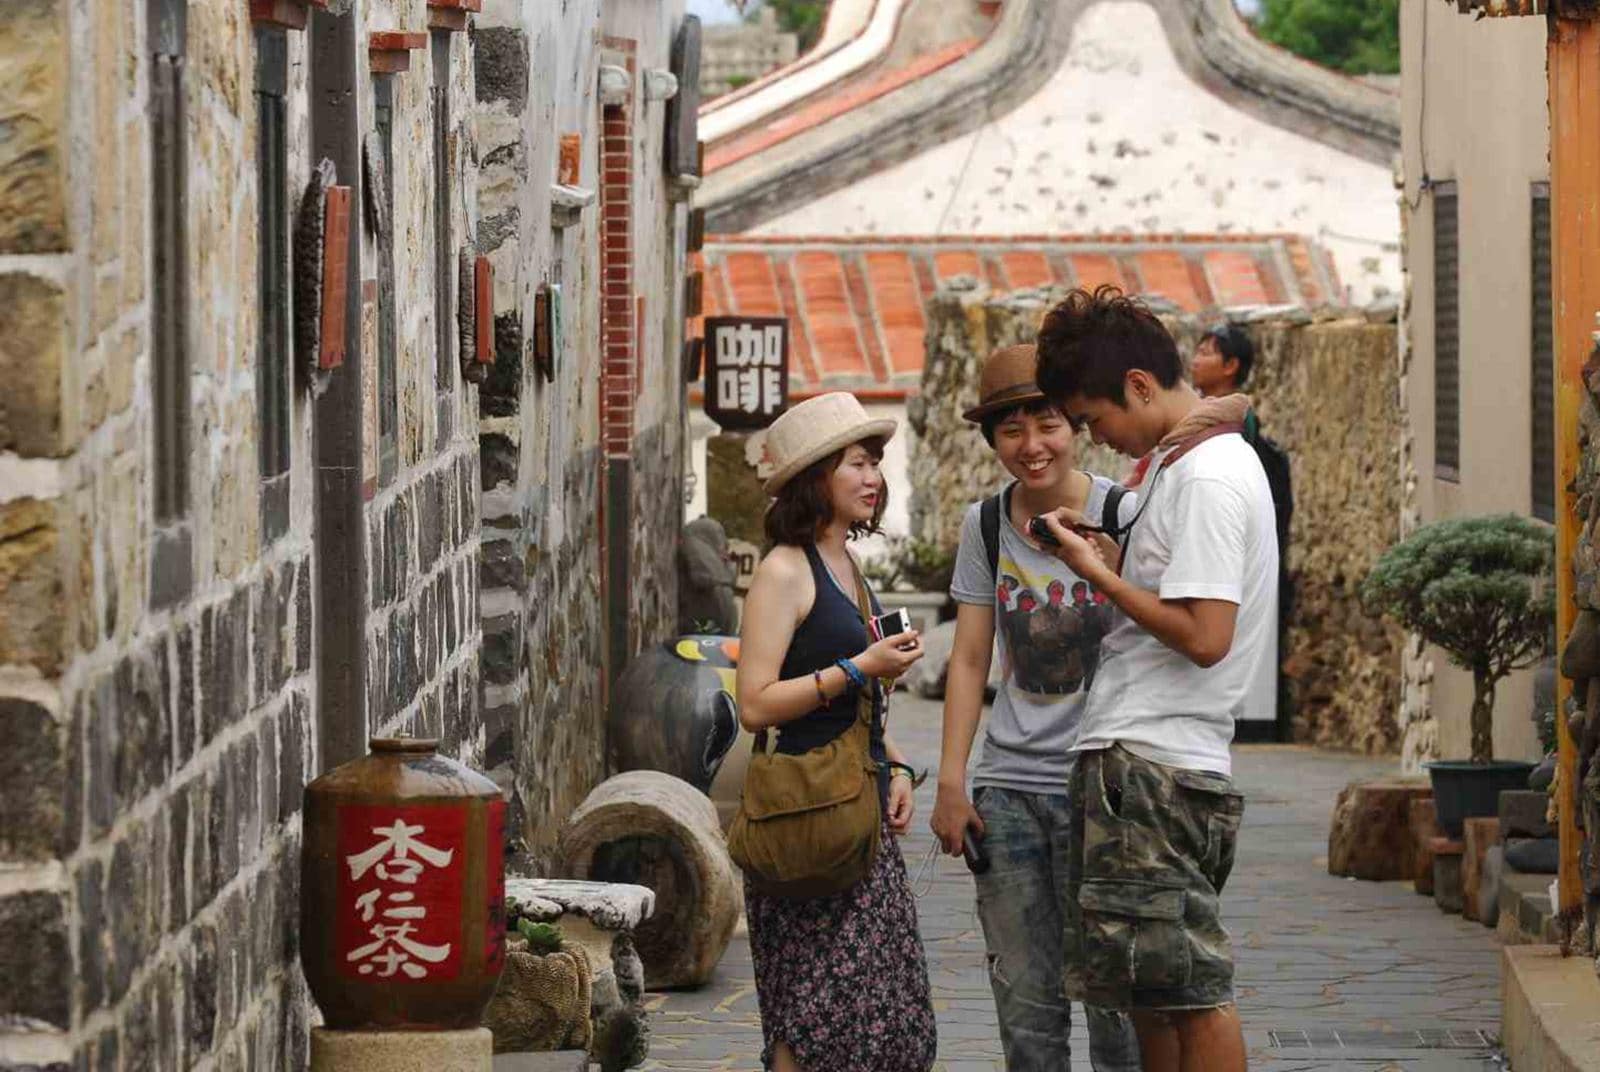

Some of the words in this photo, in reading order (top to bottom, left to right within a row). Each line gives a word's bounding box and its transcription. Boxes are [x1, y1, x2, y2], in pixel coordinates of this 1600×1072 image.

[716, 323, 783, 415] 咖啡
[347, 818, 454, 979] 杏仁茶
